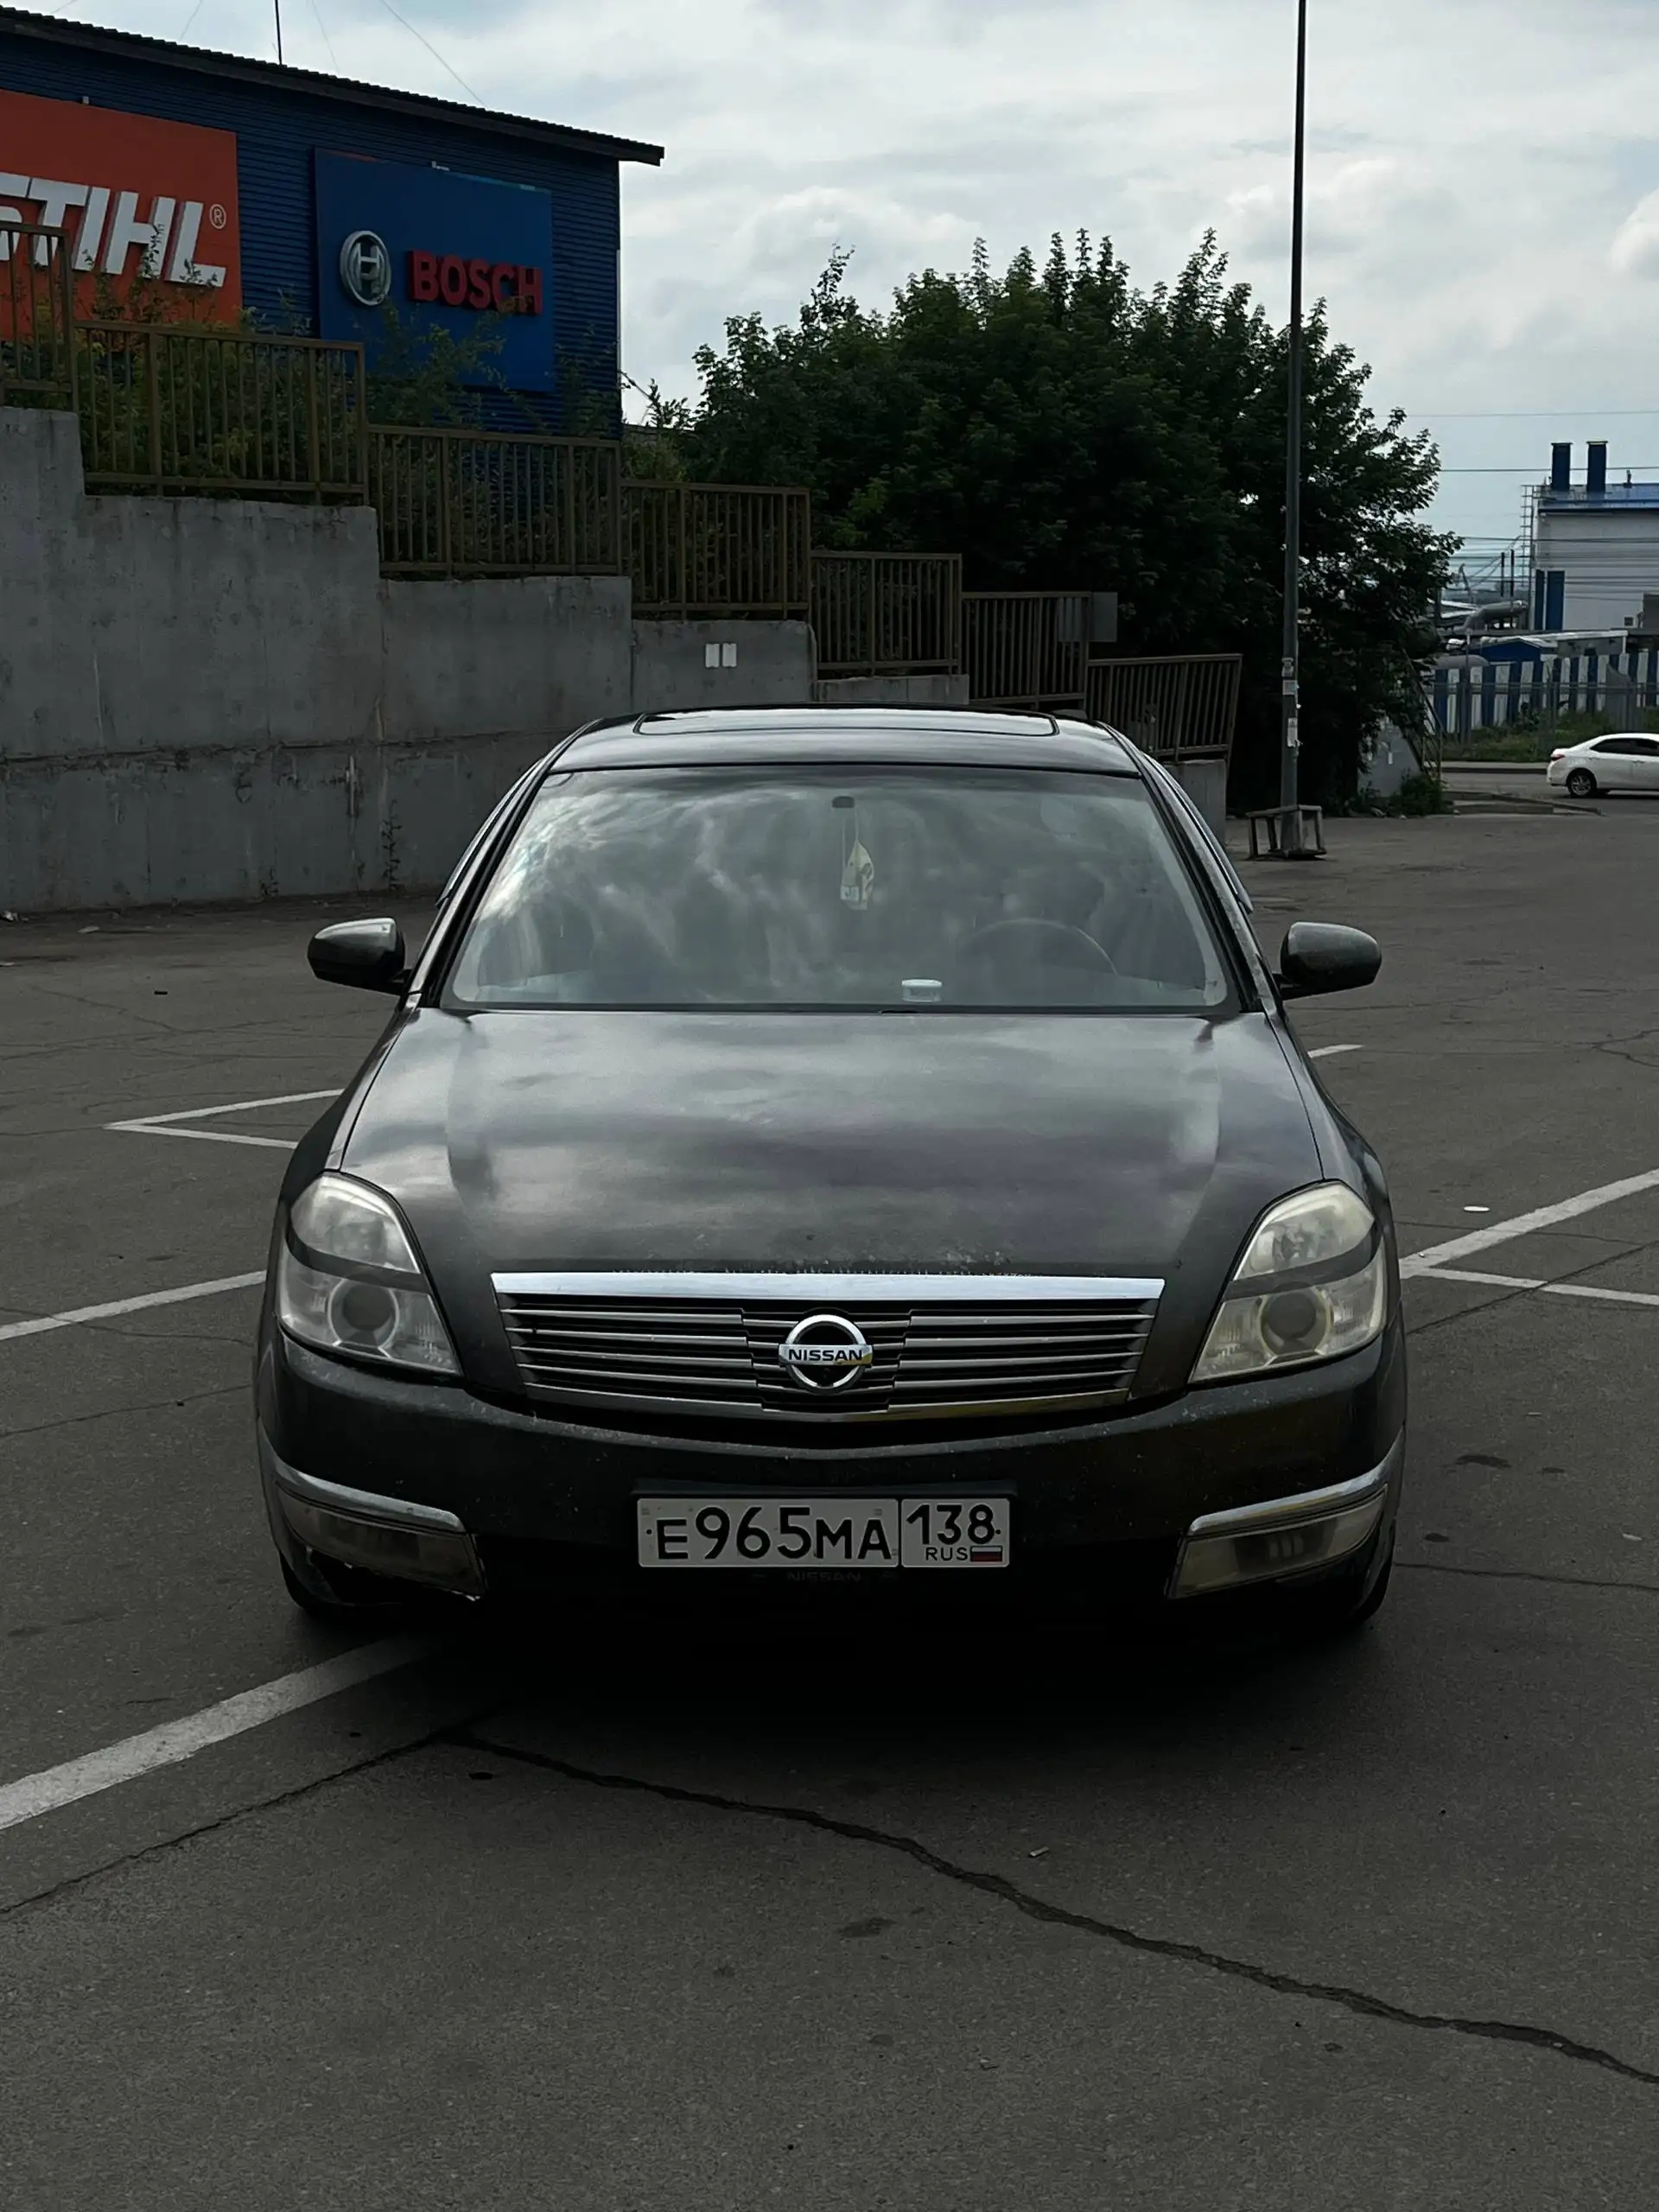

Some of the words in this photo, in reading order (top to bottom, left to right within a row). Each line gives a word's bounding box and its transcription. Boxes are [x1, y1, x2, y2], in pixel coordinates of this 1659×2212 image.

[405, 250, 543, 315] BOSCH
[788, 1349, 862, 1361] NISSAN
[657, 1506, 892, 1559] E965MA
[906, 1504, 995, 1545] 138
[925, 1547, 968, 1561] RUS
